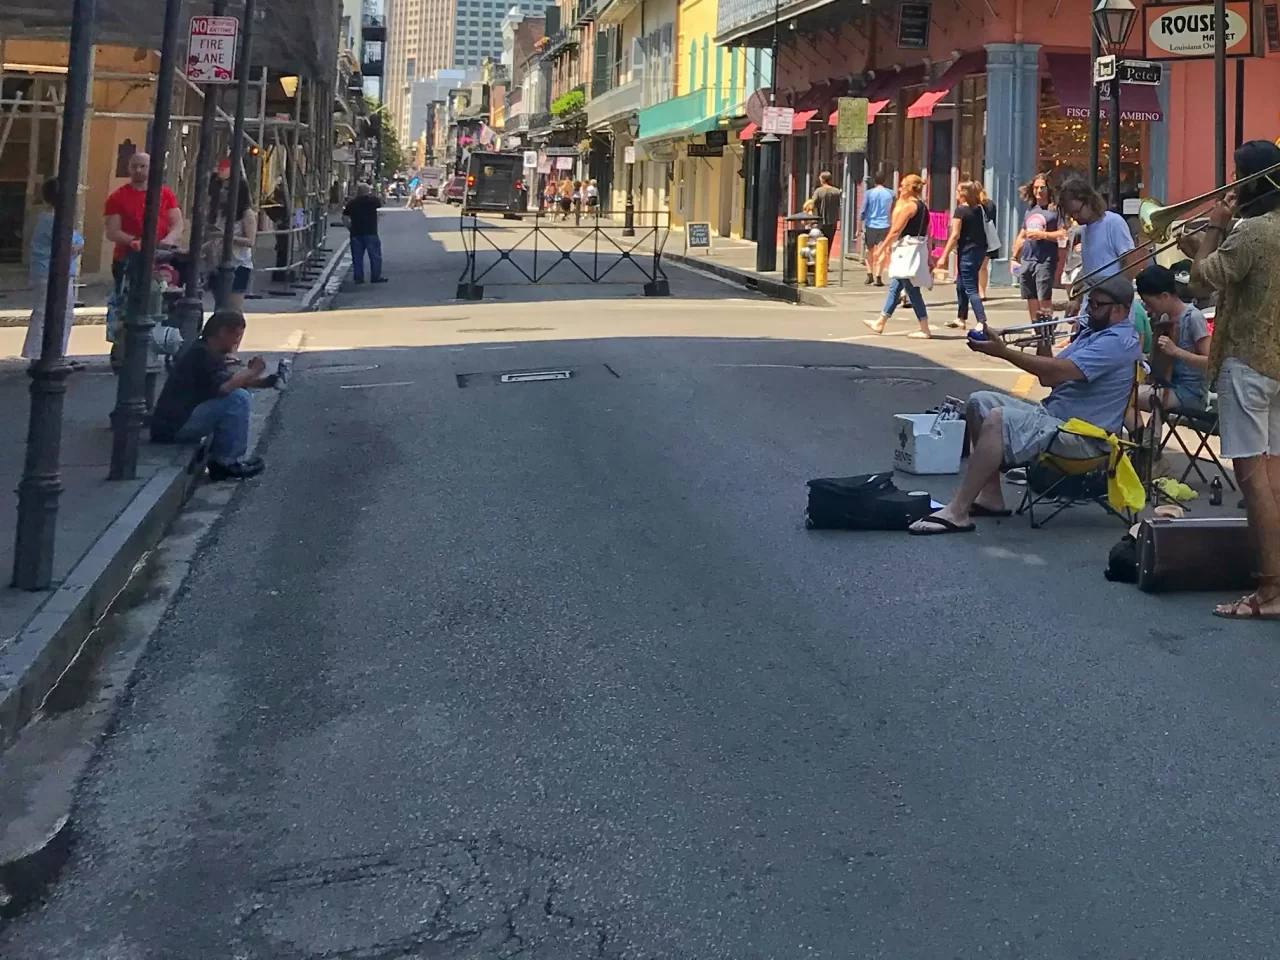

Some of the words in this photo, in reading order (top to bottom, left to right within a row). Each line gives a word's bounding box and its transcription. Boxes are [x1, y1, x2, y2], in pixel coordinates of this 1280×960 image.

[192, 20, 207, 33] NO
[200, 39, 225, 50] FIRE
[198, 53, 225, 64] LANE
[1127, 68, 1160, 81] Peter
[1119, 112, 1160, 121] AMBINO
